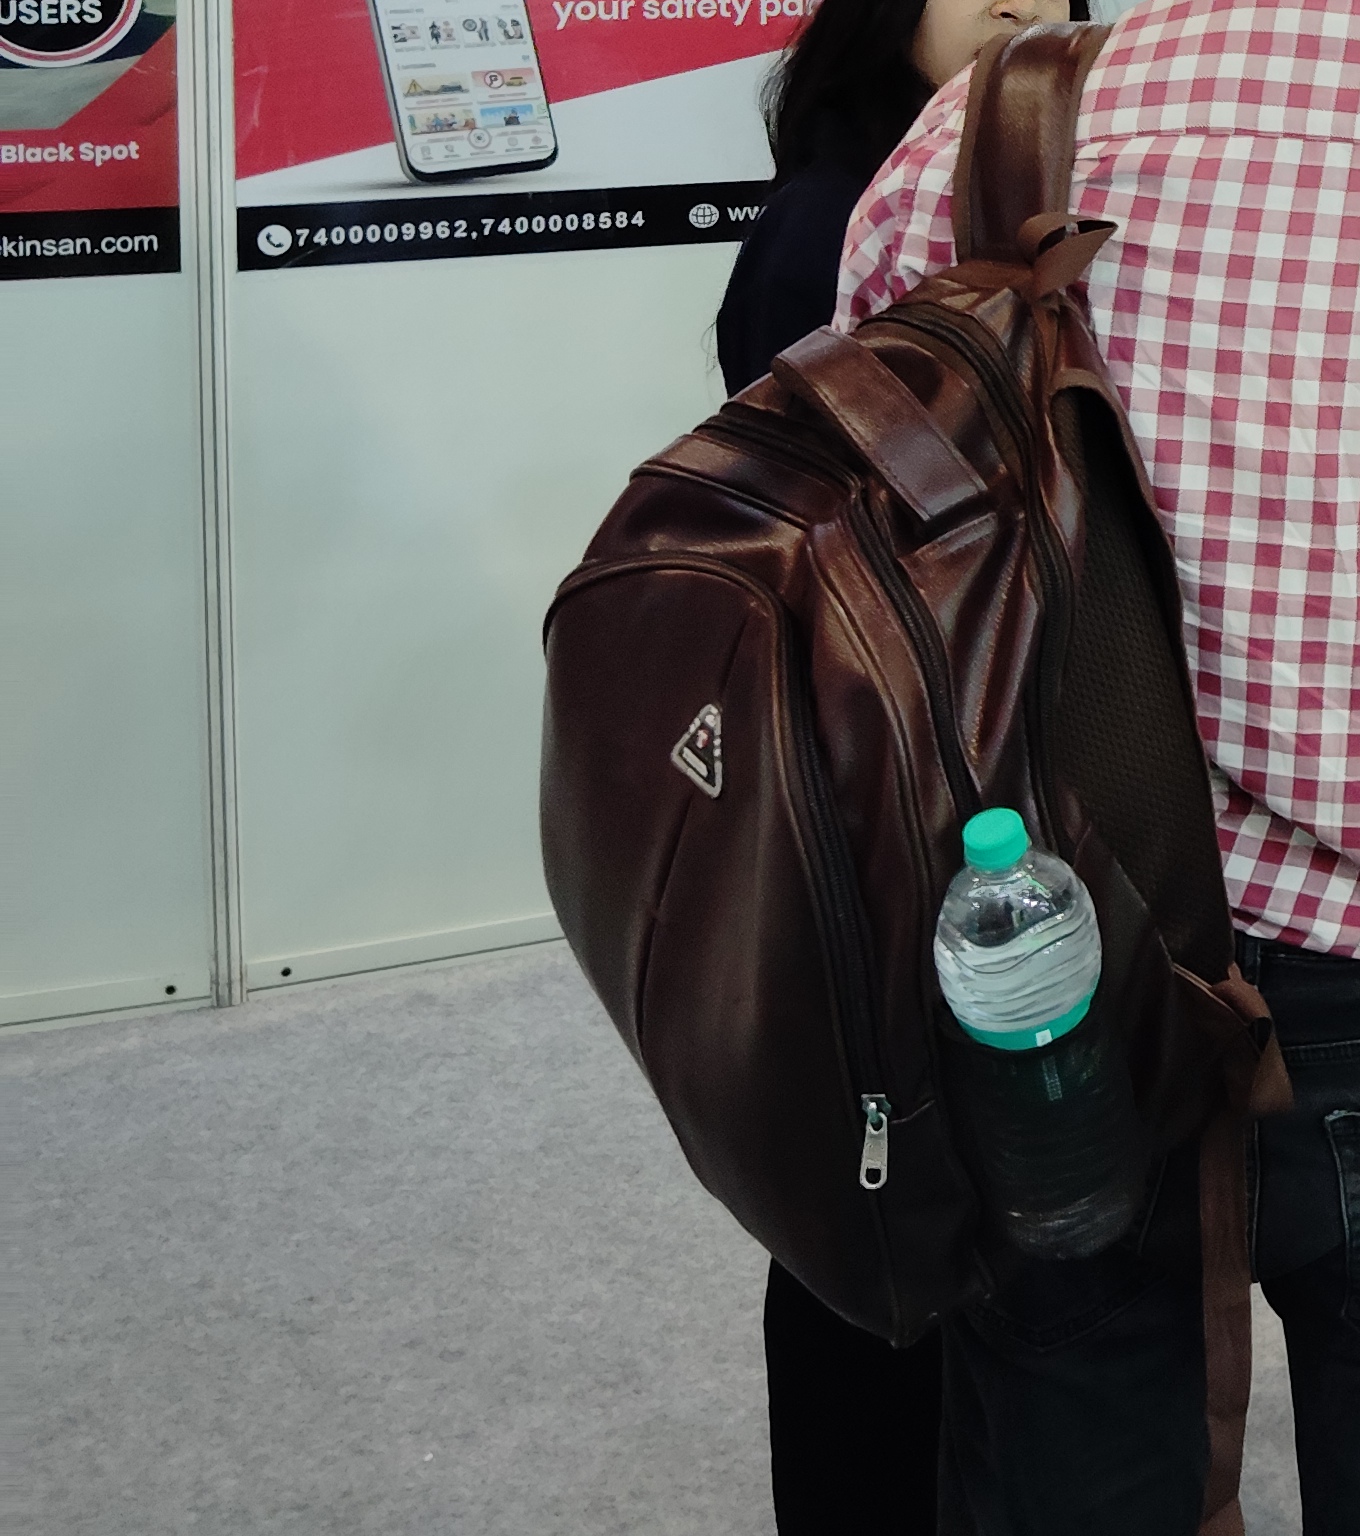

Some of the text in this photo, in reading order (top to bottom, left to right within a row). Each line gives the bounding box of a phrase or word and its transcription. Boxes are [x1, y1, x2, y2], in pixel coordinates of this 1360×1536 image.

[1, 140, 140, 166] Black Spot
[0, 233, 158, 258] kinsan.com
